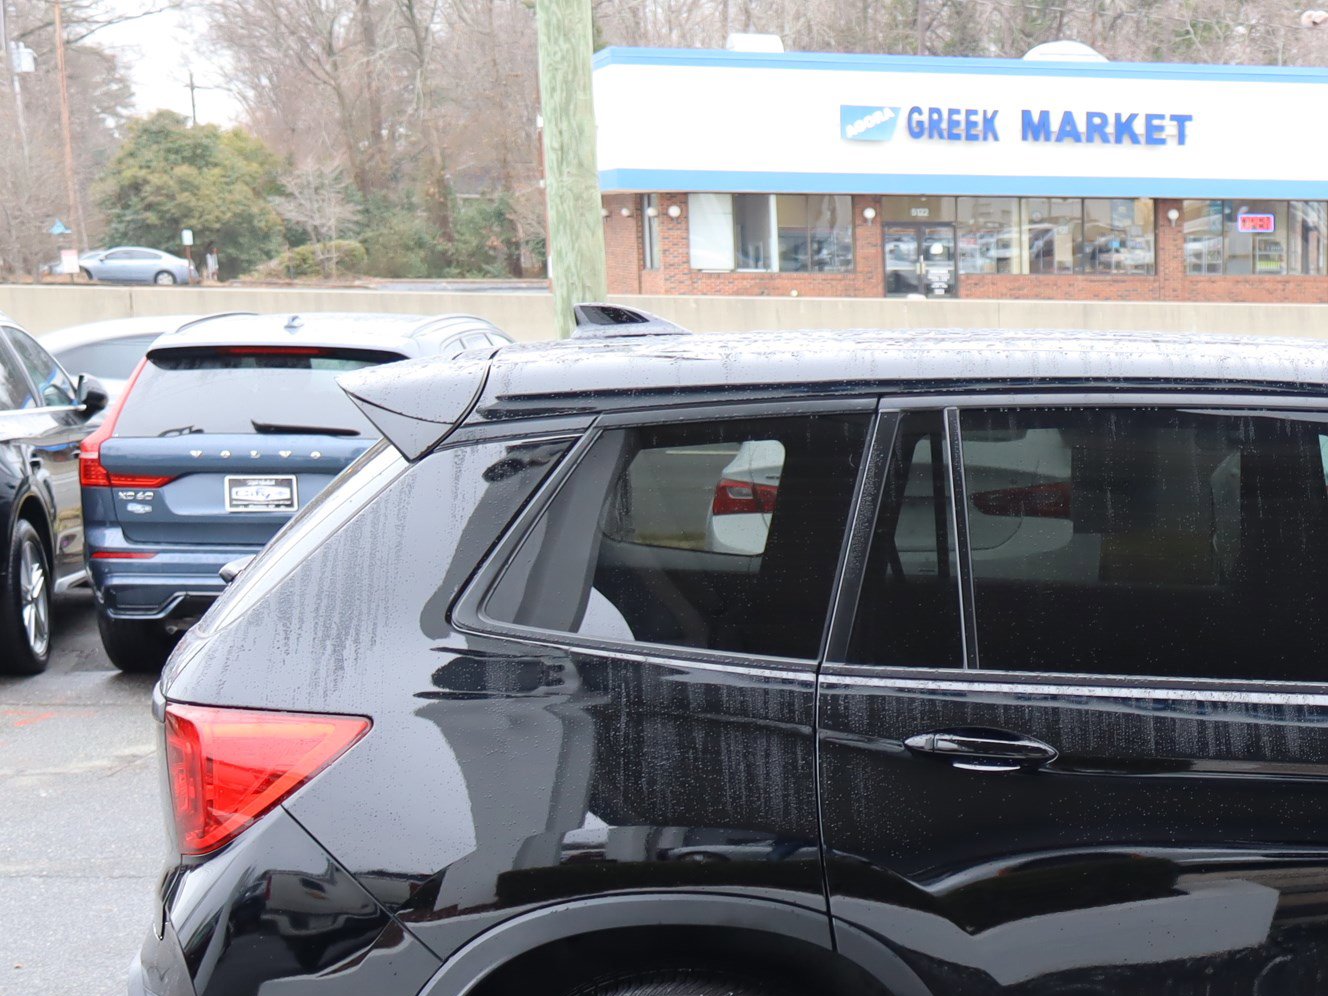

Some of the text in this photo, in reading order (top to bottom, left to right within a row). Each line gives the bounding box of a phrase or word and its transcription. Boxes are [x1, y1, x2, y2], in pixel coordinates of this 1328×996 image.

[906, 105, 1194, 146] GREEK MARKET
[188, 449, 323, 459] VOLVO
